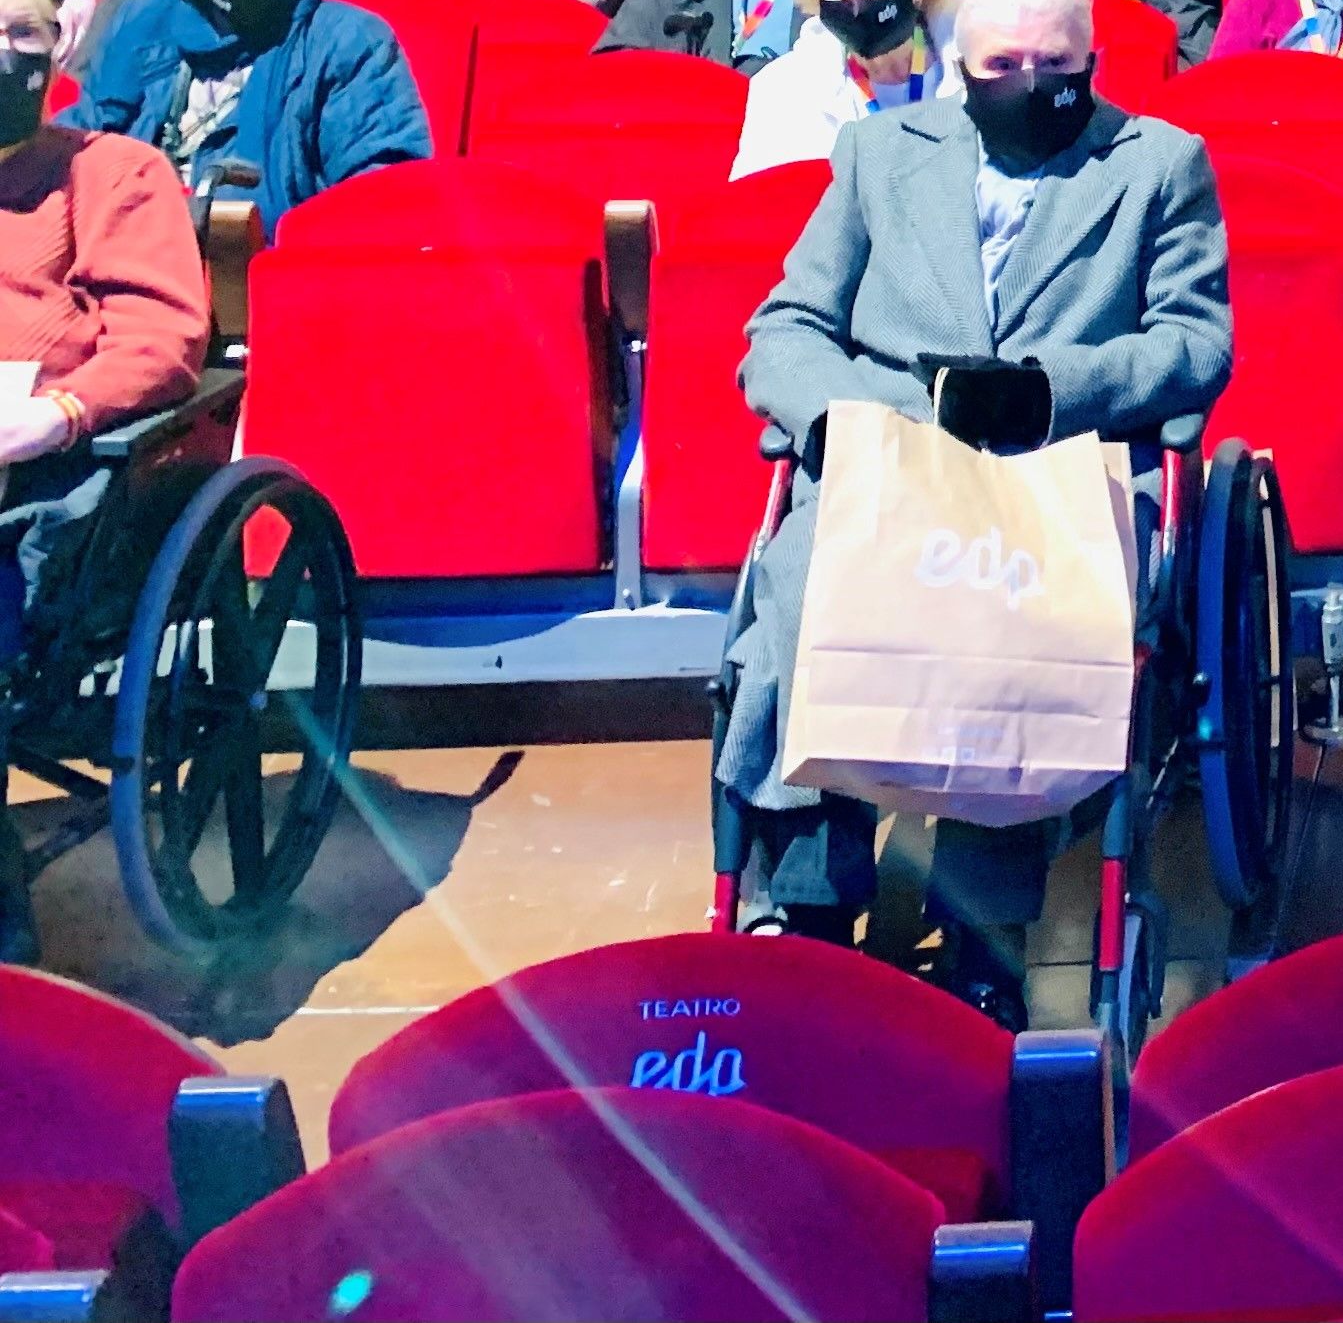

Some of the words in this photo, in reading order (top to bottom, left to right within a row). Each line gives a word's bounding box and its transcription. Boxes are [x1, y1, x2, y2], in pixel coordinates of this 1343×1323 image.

[913, 525, 1047, 613] edp
[638, 997, 741, 1020] TEATRO
[629, 1029, 748, 1097] edp
